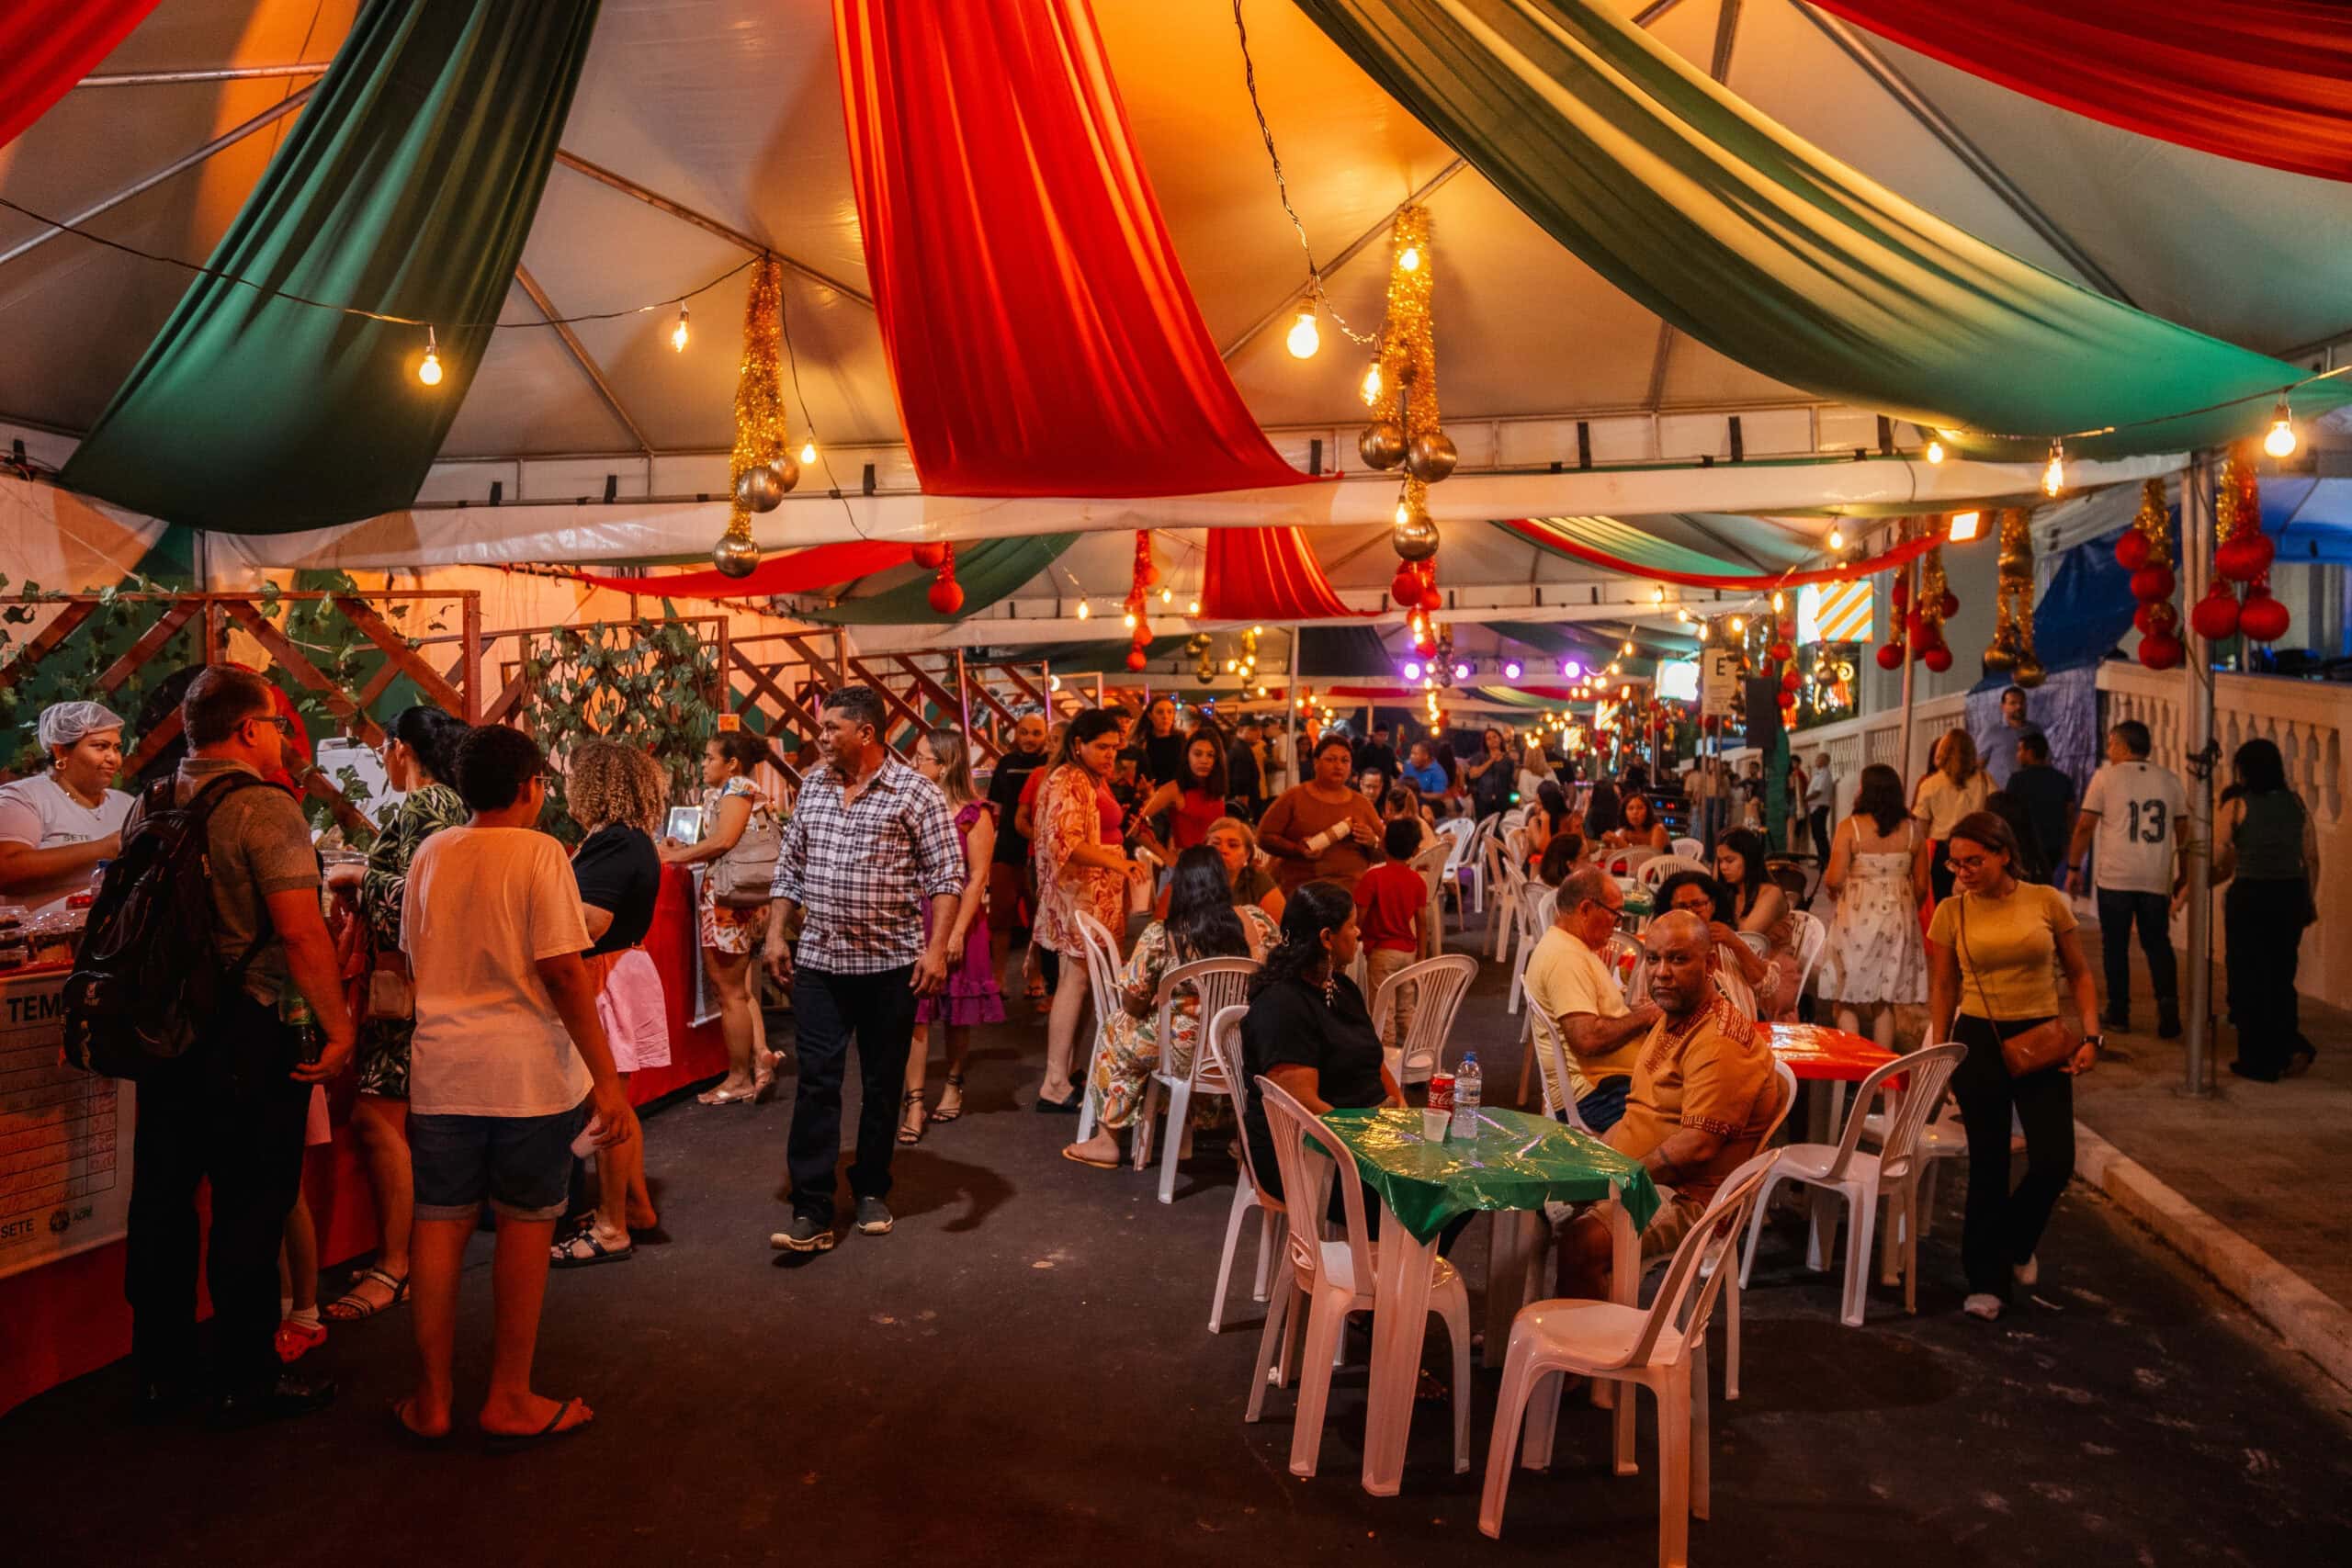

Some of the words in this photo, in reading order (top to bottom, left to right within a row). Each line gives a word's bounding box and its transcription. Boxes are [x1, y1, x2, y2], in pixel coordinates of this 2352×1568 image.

[1715, 657, 1726, 676] E
[2128, 798, 2166, 843] 13
[0, 1218, 35, 1238] SETE
